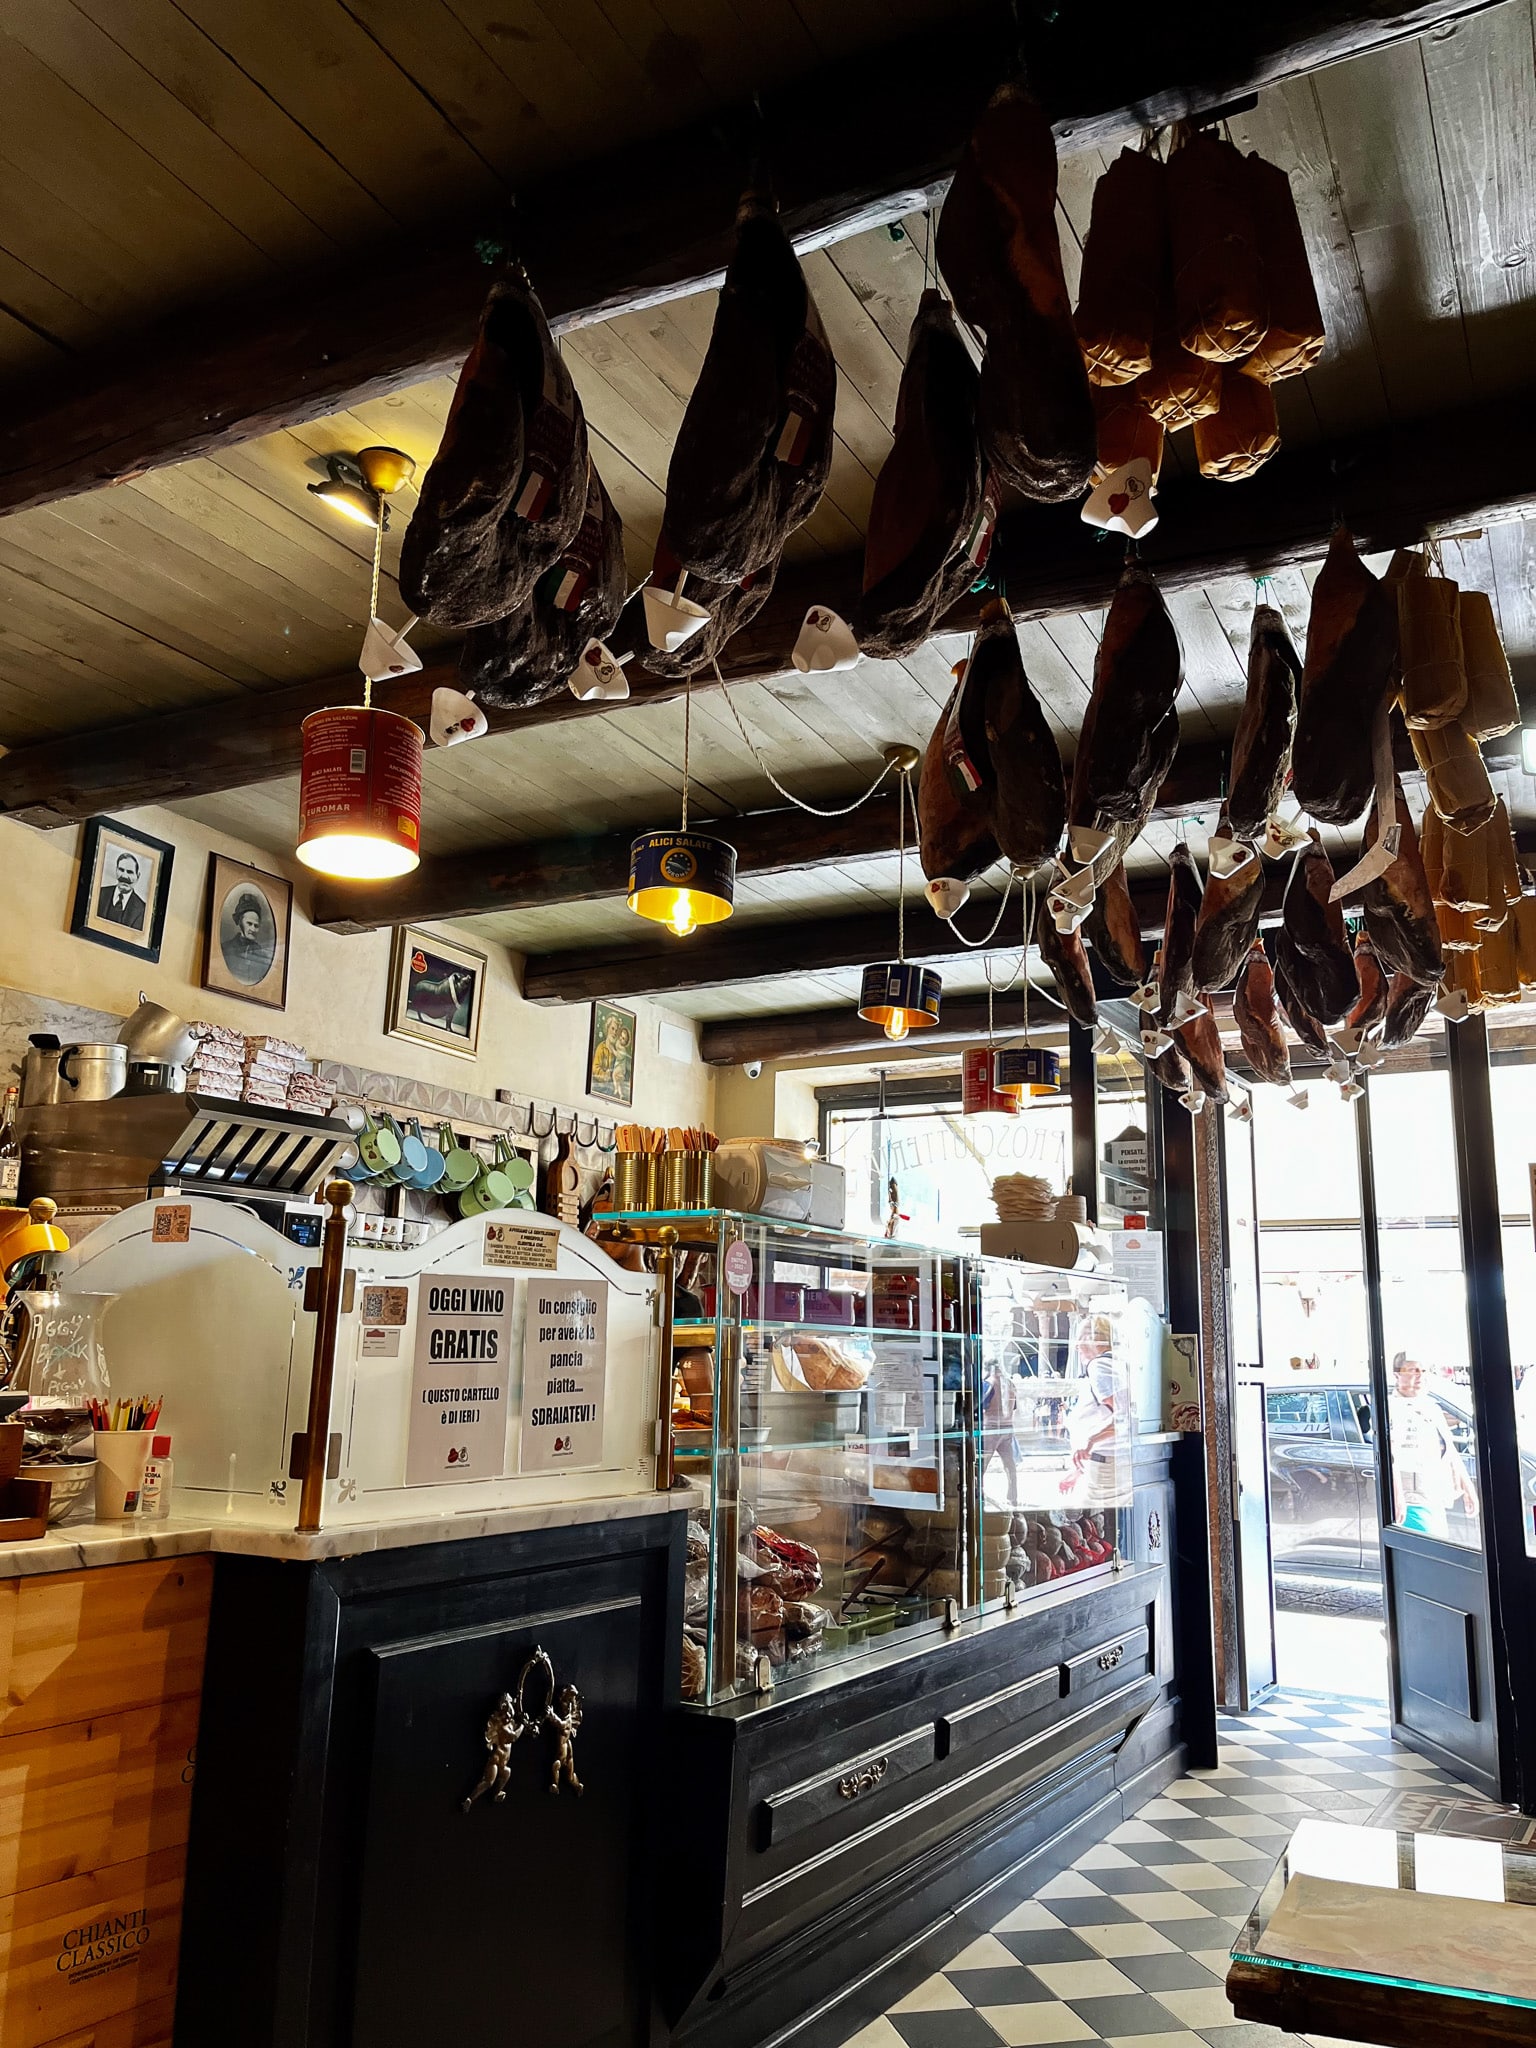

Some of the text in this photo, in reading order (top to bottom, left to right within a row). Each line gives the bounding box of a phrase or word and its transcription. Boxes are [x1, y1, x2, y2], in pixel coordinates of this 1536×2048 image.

[307, 803, 350, 817] EUROMAR
[649, 837, 713, 850] ALICI SALATE
[429, 1287, 467, 1312] OGGI
[470, 1288, 504, 1313] VINO
[539, 1298, 597, 1317] Un consiglio
[539, 1324, 595, 1343] per avere la
[430, 1328, 499, 1360] GRATIS
[550, 1350, 583, 1369] pancia
[428, 1388, 461, 1404] QUESTO
[461, 1387, 500, 1402] CARTELLO
[449, 1411, 458, 1424] DI
[459, 1410, 475, 1424] IERI
[531, 1405, 590, 1427] SDRAIATEVI
[63, 1908, 147, 1950] CHIANTI
[56, 1926, 150, 1972] CLASSICO
